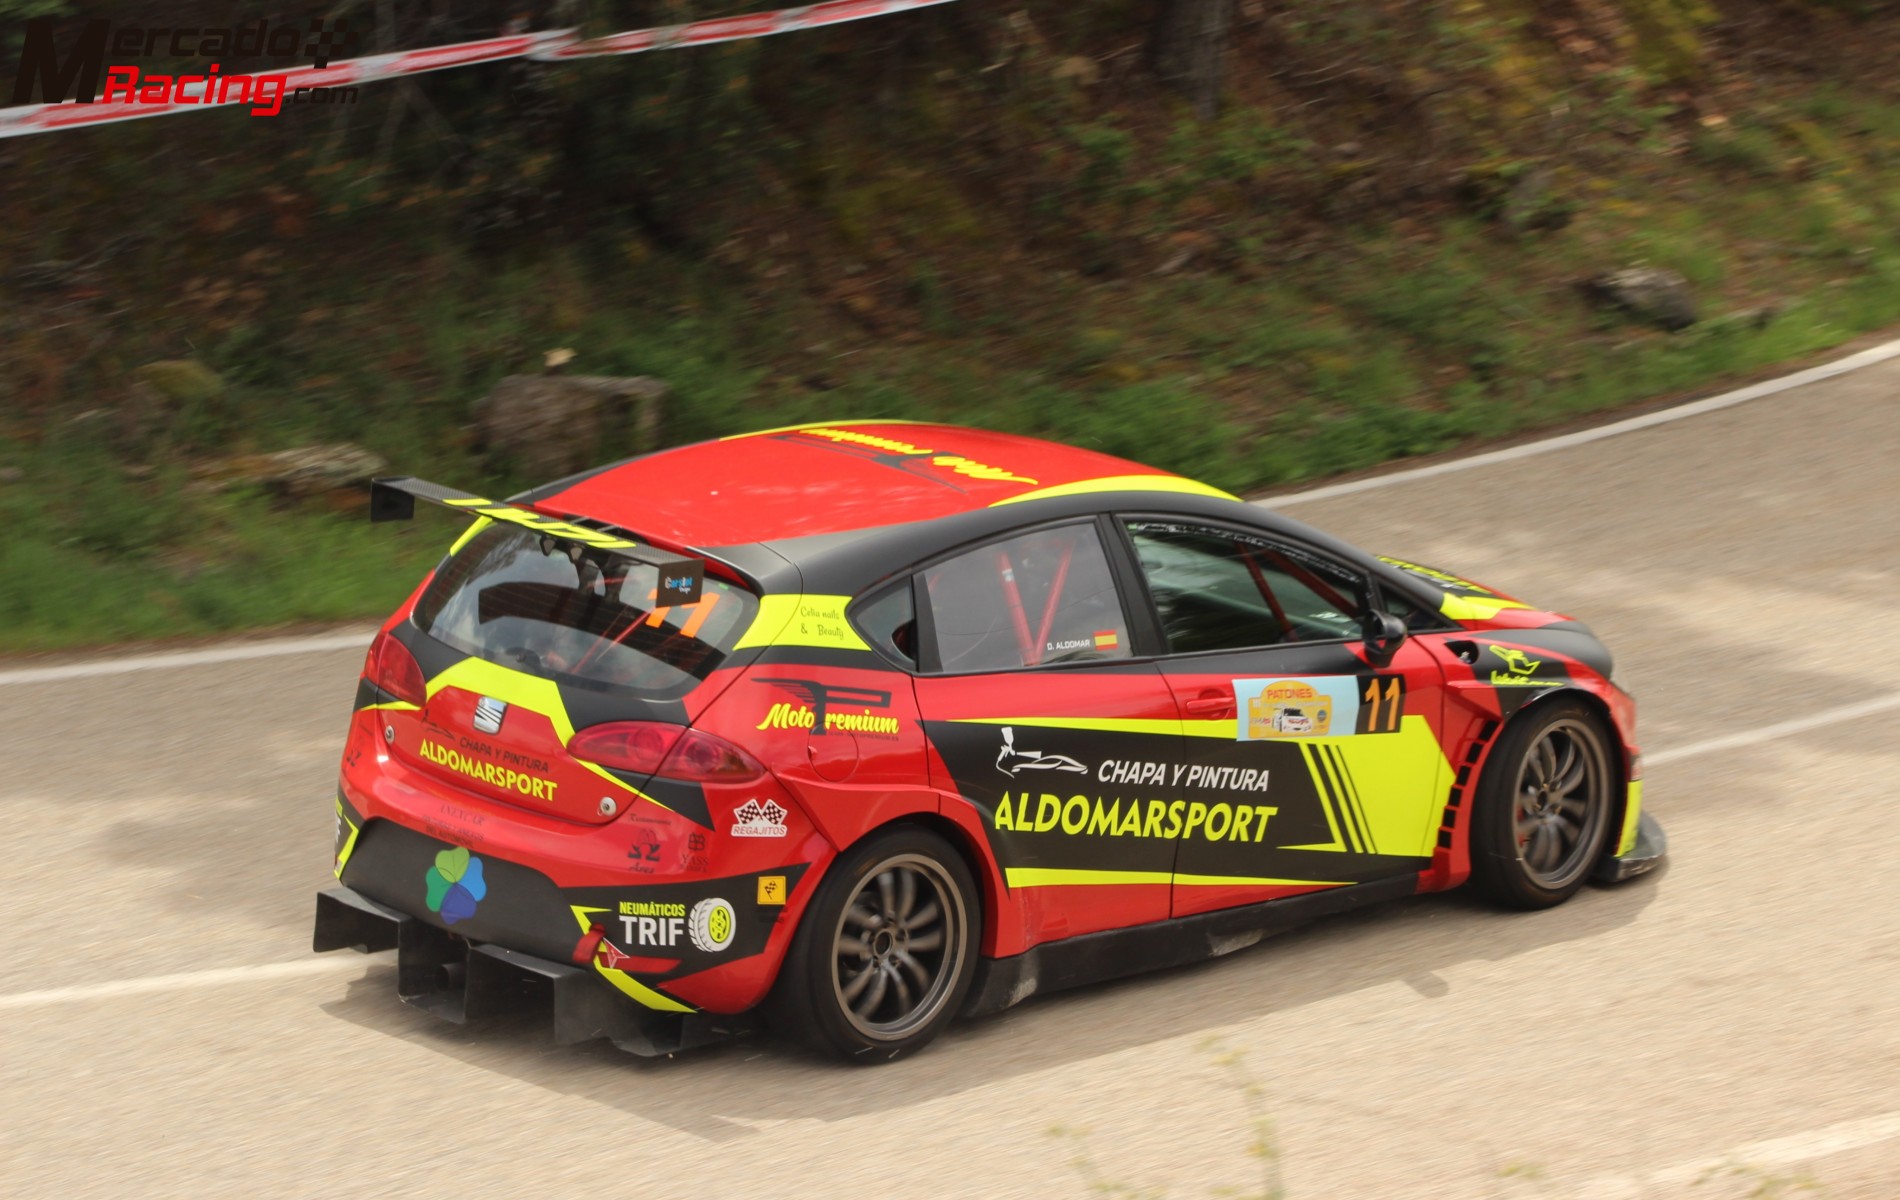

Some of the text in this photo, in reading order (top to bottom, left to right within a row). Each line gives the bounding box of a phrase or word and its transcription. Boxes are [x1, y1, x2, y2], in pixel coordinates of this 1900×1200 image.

[800, 606, 839, 620] Celia nails
[800, 622, 844, 641] & Beauty
[1056, 638, 1091, 650] ALDOMAR
[1266, 688, 1313, 699] PATONES
[1365, 677, 1401, 732] 11
[755, 702, 815, 731] Moto
[419, 737, 558, 802] ALDOMARSPORT
[459, 736, 549, 774] CHAPA Y PINTURA
[1097, 759, 1270, 792] CHAPA Y PINTURA
[732, 825, 786, 836] REGAJITOS
[994, 790, 1279, 843] ALDOMARSPORT
[618, 900, 686, 917] NEUMÁTICOS
[618, 916, 685, 947] TRIF
